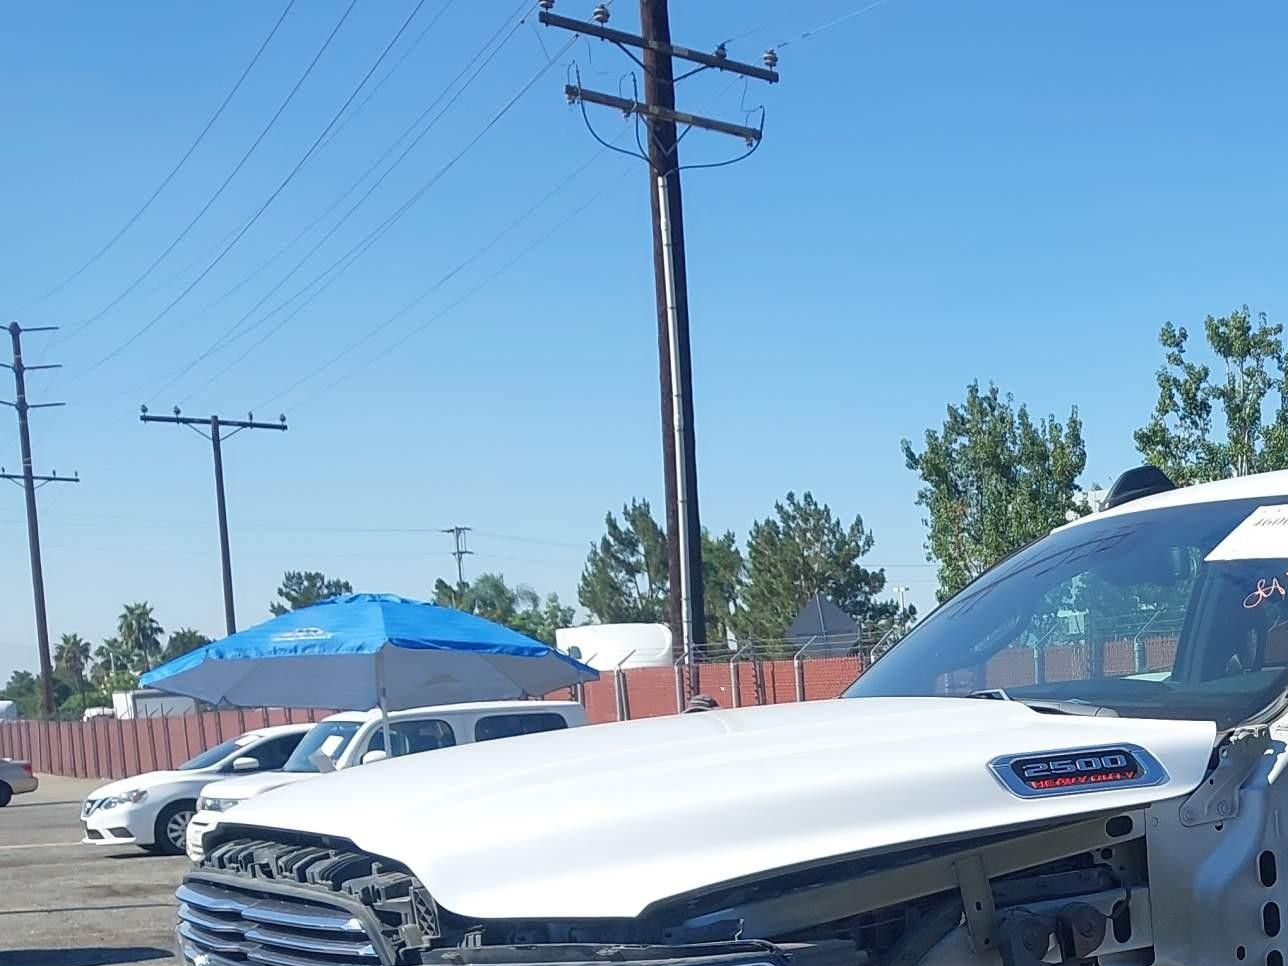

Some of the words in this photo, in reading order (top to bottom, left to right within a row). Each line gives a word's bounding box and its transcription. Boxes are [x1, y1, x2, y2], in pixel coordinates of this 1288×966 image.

[1022, 754, 1128, 777] 2500
[1031, 775, 1088, 788] HEAVY
[1090, 771, 1135, 782] DUTY
